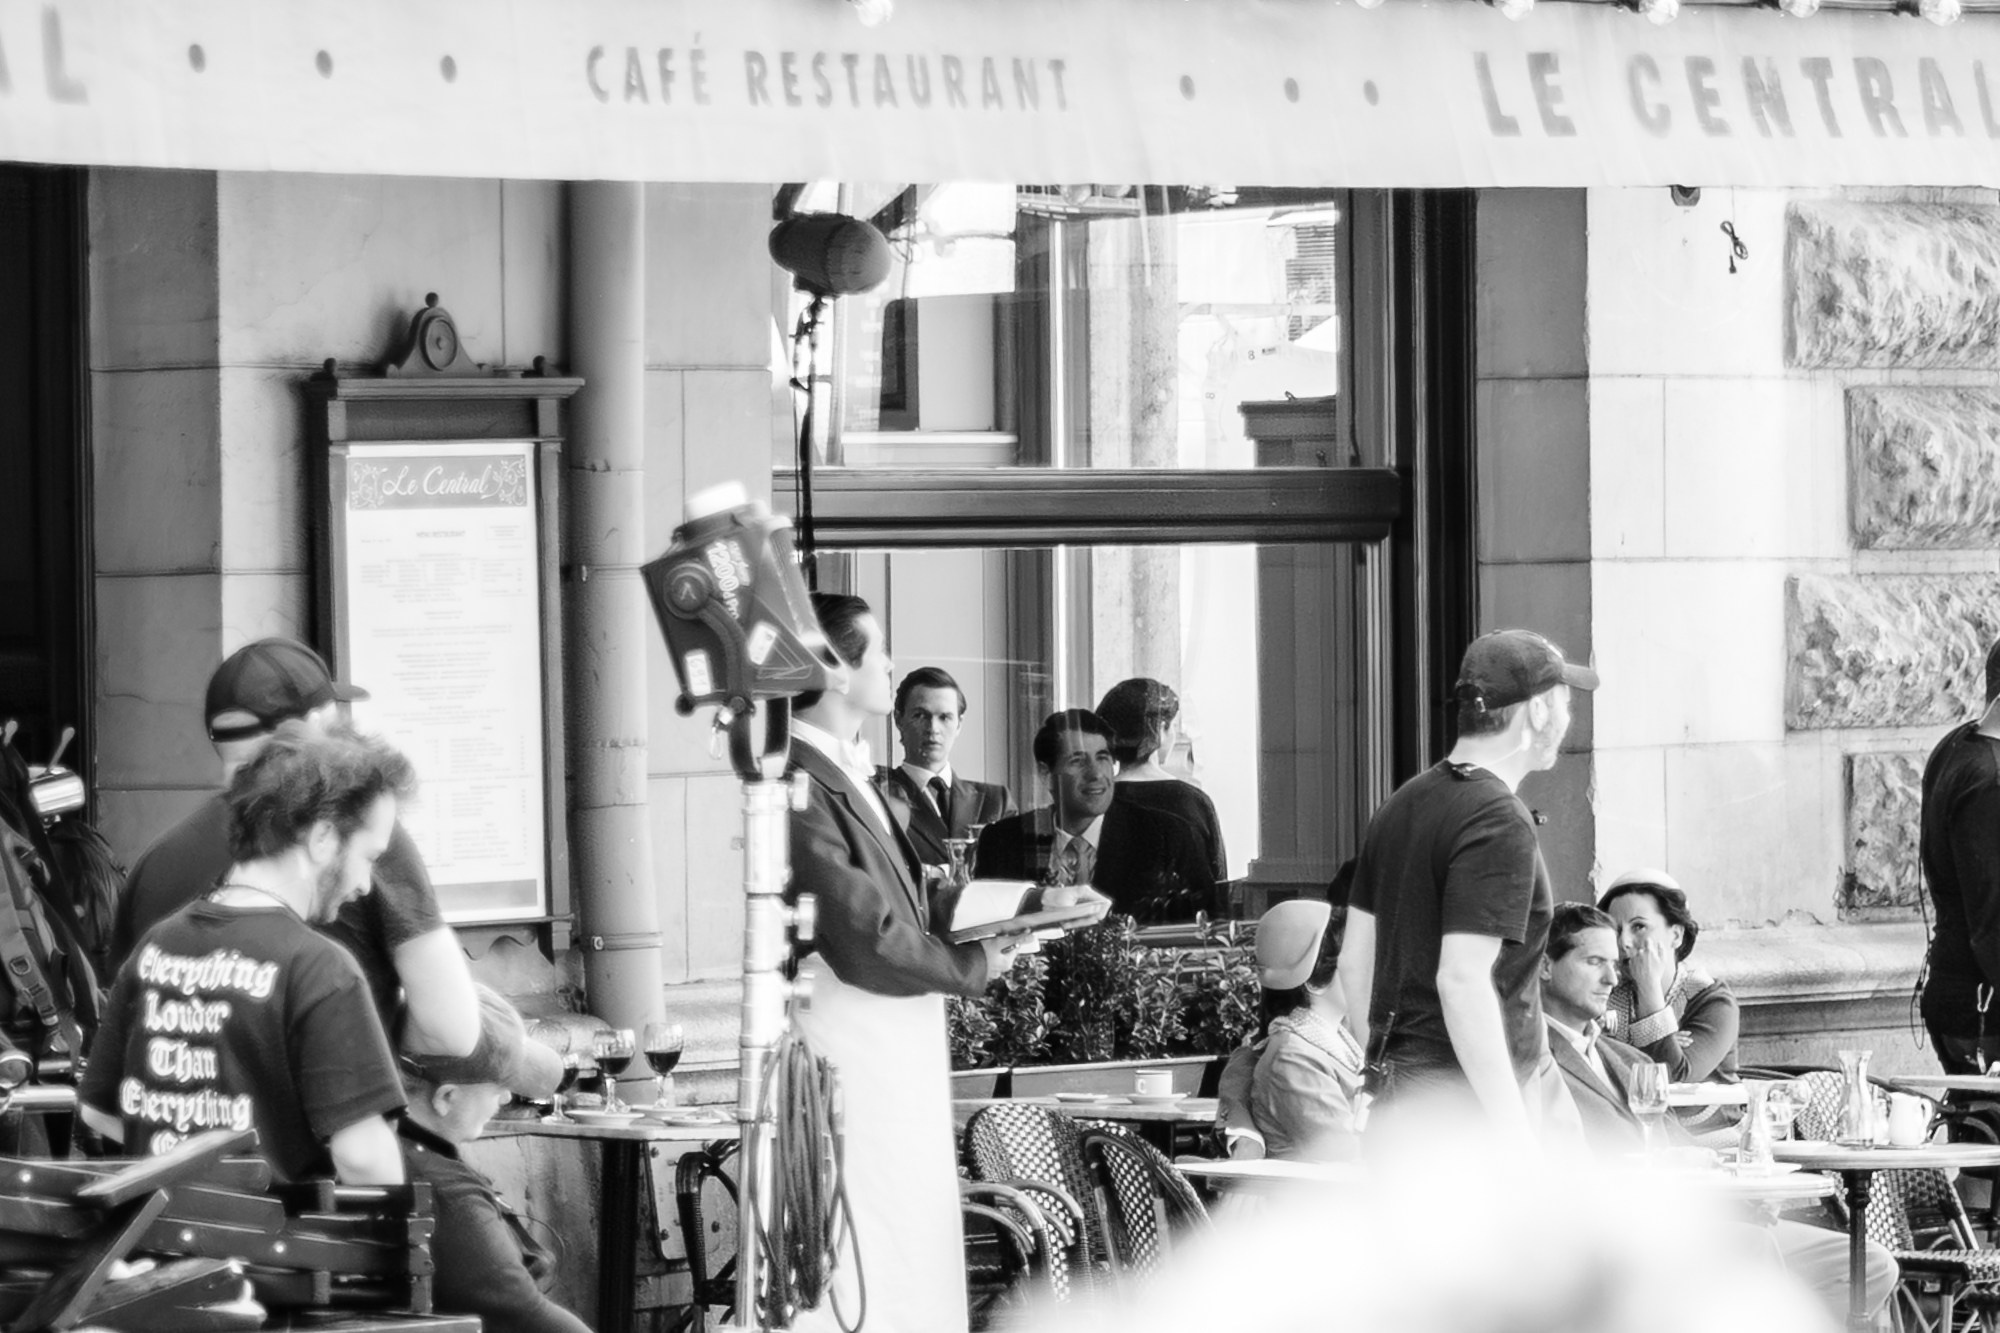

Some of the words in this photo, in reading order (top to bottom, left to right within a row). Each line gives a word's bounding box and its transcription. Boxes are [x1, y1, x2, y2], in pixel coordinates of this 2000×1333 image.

[586, 32, 710, 104] CAFÉ
[743, 50, 1068, 112] RESTAURANT
[1473, 51, 1578, 138] LE
[382, 465, 417, 495] Le
[423, 465, 492, 495] Central
[139, 945, 279, 998] Everything
[145, 989, 231, 1034] Louder
[149, 1038, 217, 1082] Than
[121, 1078, 251, 1131] Everything
